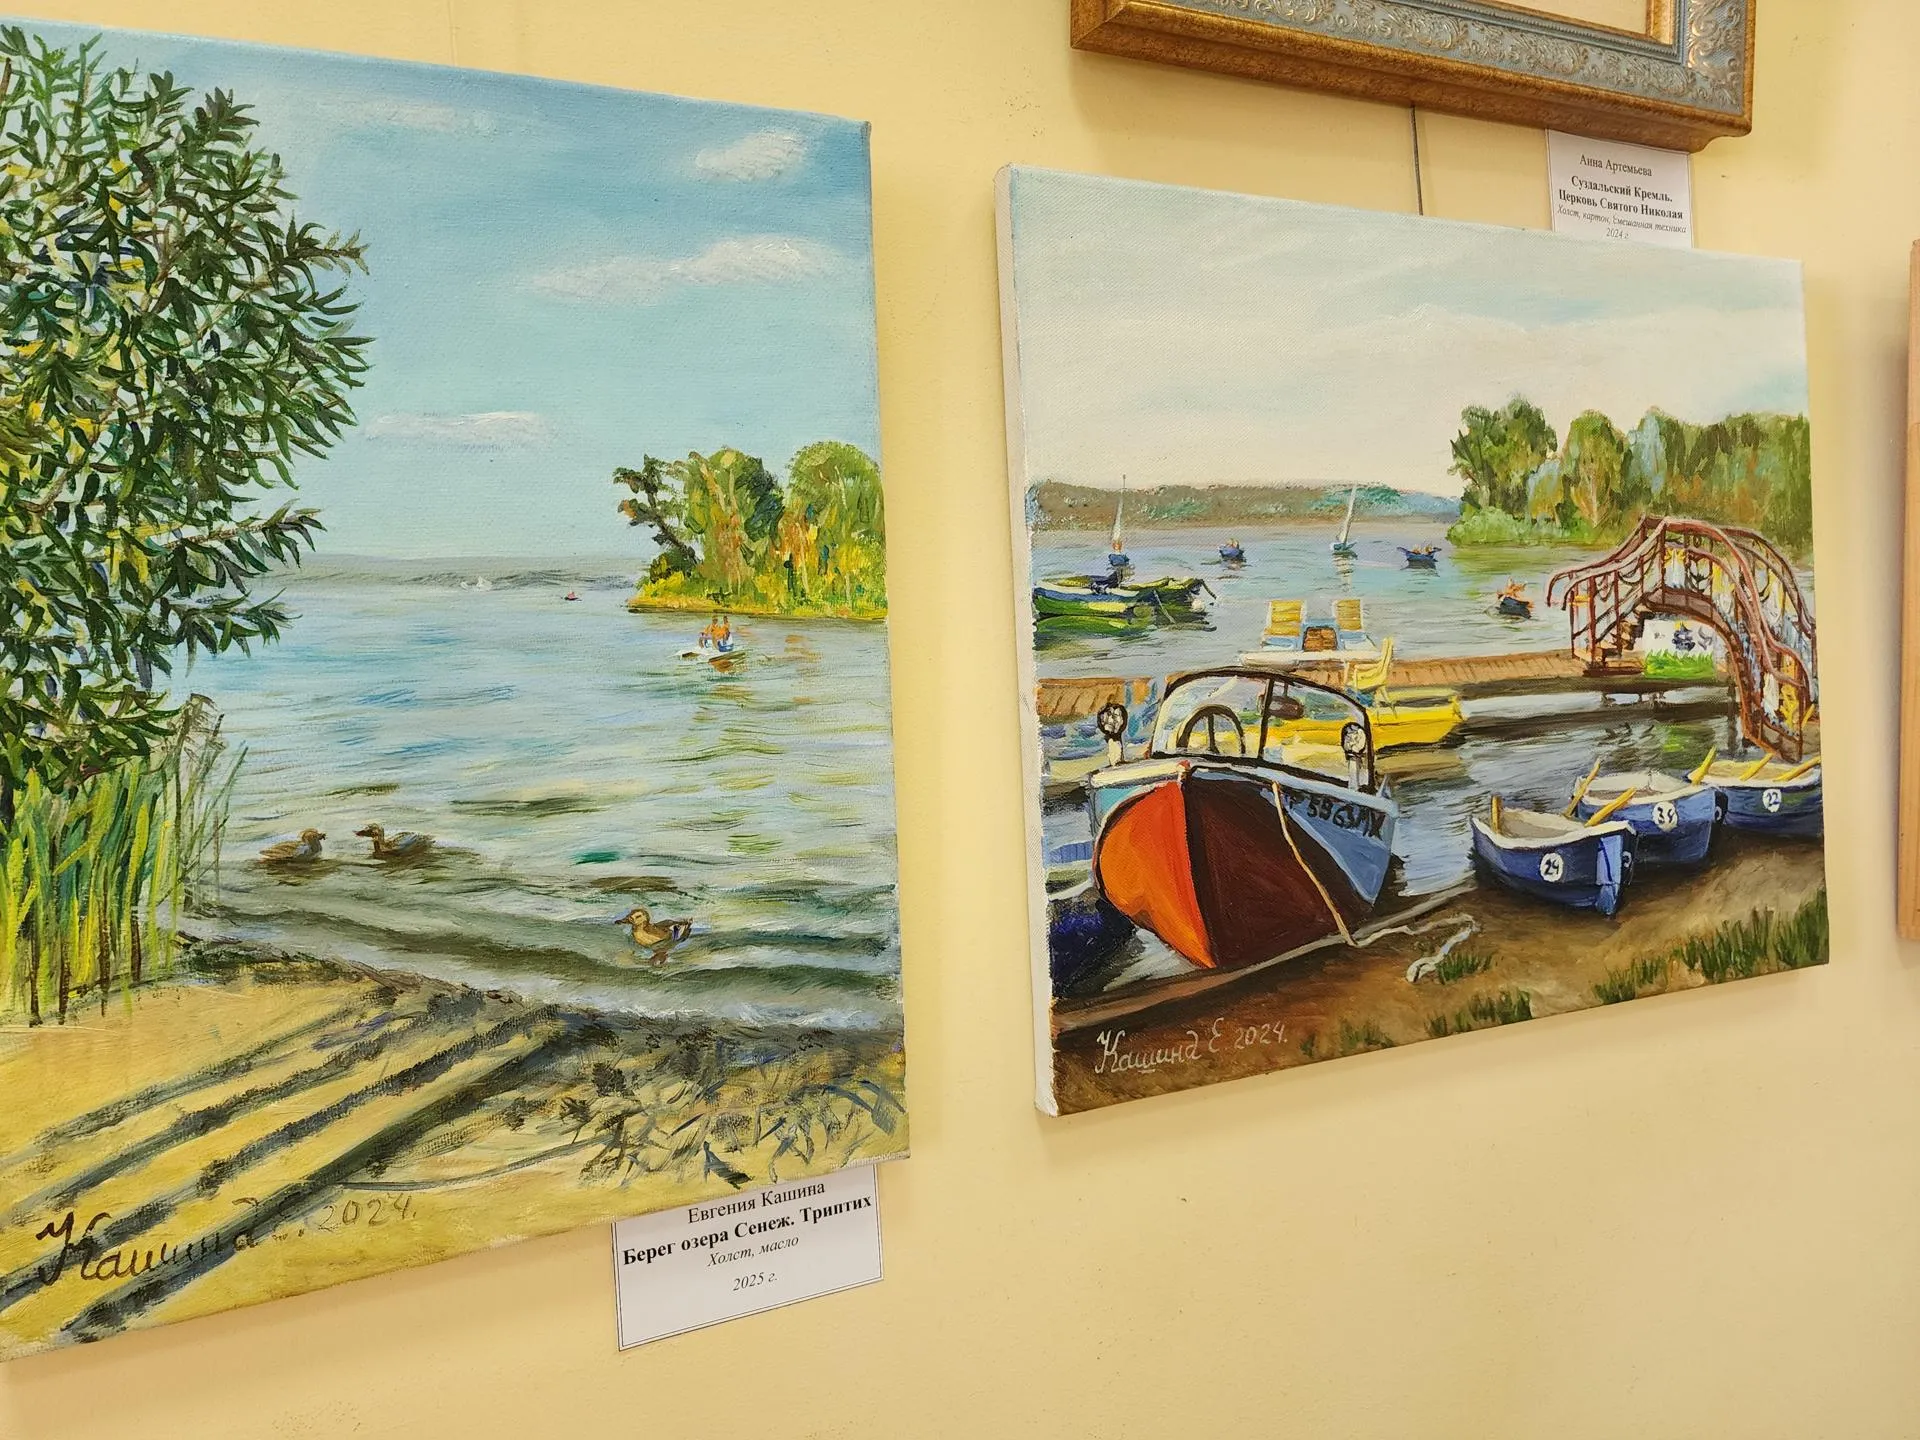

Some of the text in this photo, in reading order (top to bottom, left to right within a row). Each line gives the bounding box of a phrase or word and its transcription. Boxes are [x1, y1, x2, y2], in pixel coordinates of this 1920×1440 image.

[1580, 154, 1652, 177] Анна Артемьева
[1571, 175, 1673, 202] Суздальский Кремль.
[1557, 204, 1580, 219] Холст,
[1655, 224, 1687, 234] техника
[1559, 189, 1683, 220] Церковь Святого Николая
[1606, 227, 1624, 239] 2024
[687, 1182, 825, 1224] Евгения Кашина
[623, 1195, 872, 1266] Берег озера Сенеж. Триптих
[706, 1235, 799, 1267] Холст, масло
[732, 1271, 779, 1291] 2025 г.
